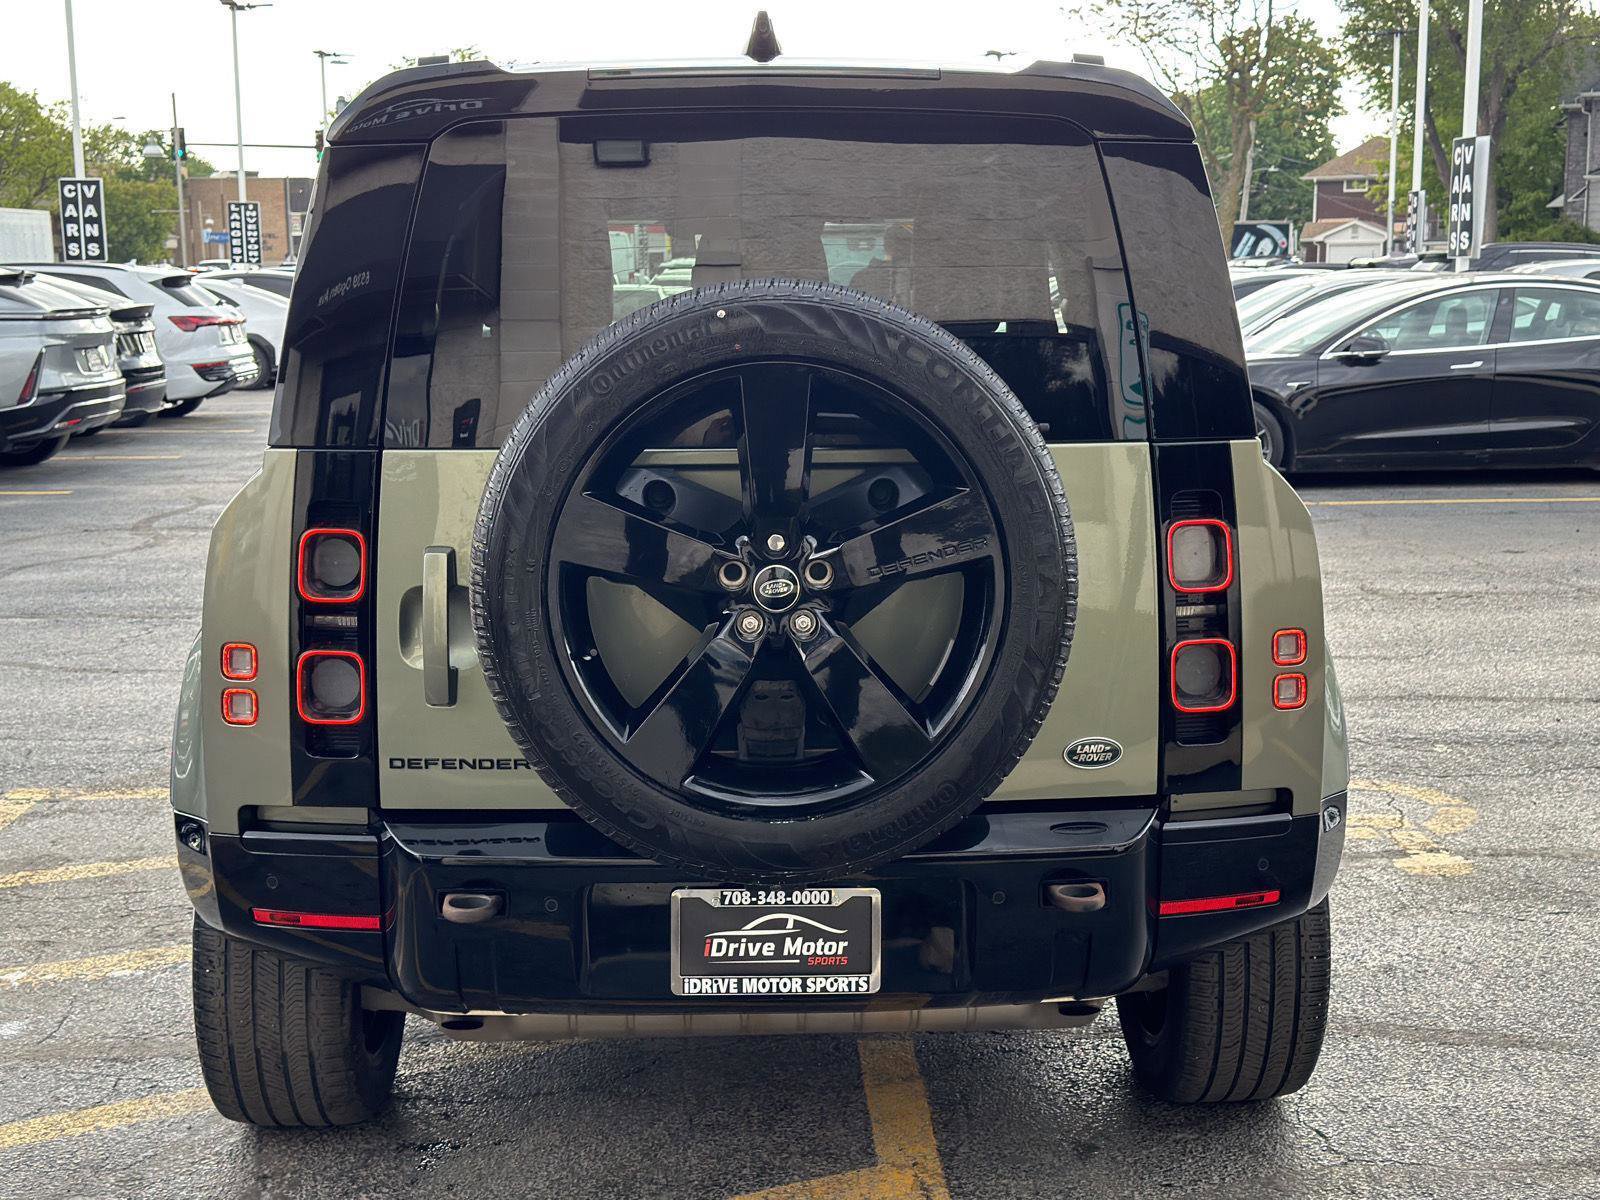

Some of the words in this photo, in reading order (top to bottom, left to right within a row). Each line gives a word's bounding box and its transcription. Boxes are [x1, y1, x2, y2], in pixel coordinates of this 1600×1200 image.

[1450, 146, 1461, 250] CARS
[1460, 145, 1473, 250] VANS
[63, 183, 80, 257] CARS
[82, 183, 100, 257] VANS
[866, 536, 990, 578] DEFENDER
[1076, 744, 1105, 754] LAND
[1078, 752, 1113, 762] ROVER
[388, 757, 532, 770] DEFENDER
[722, 890, 831, 906] 708-348-0000
[703, 937, 775, 957] iDrive
[783, 936, 849, 956] Motor
[807, 956, 849, 966] SPORTS
[742, 977, 803, 994] MOTOR
[806, 976, 868, 993] SPORTS
